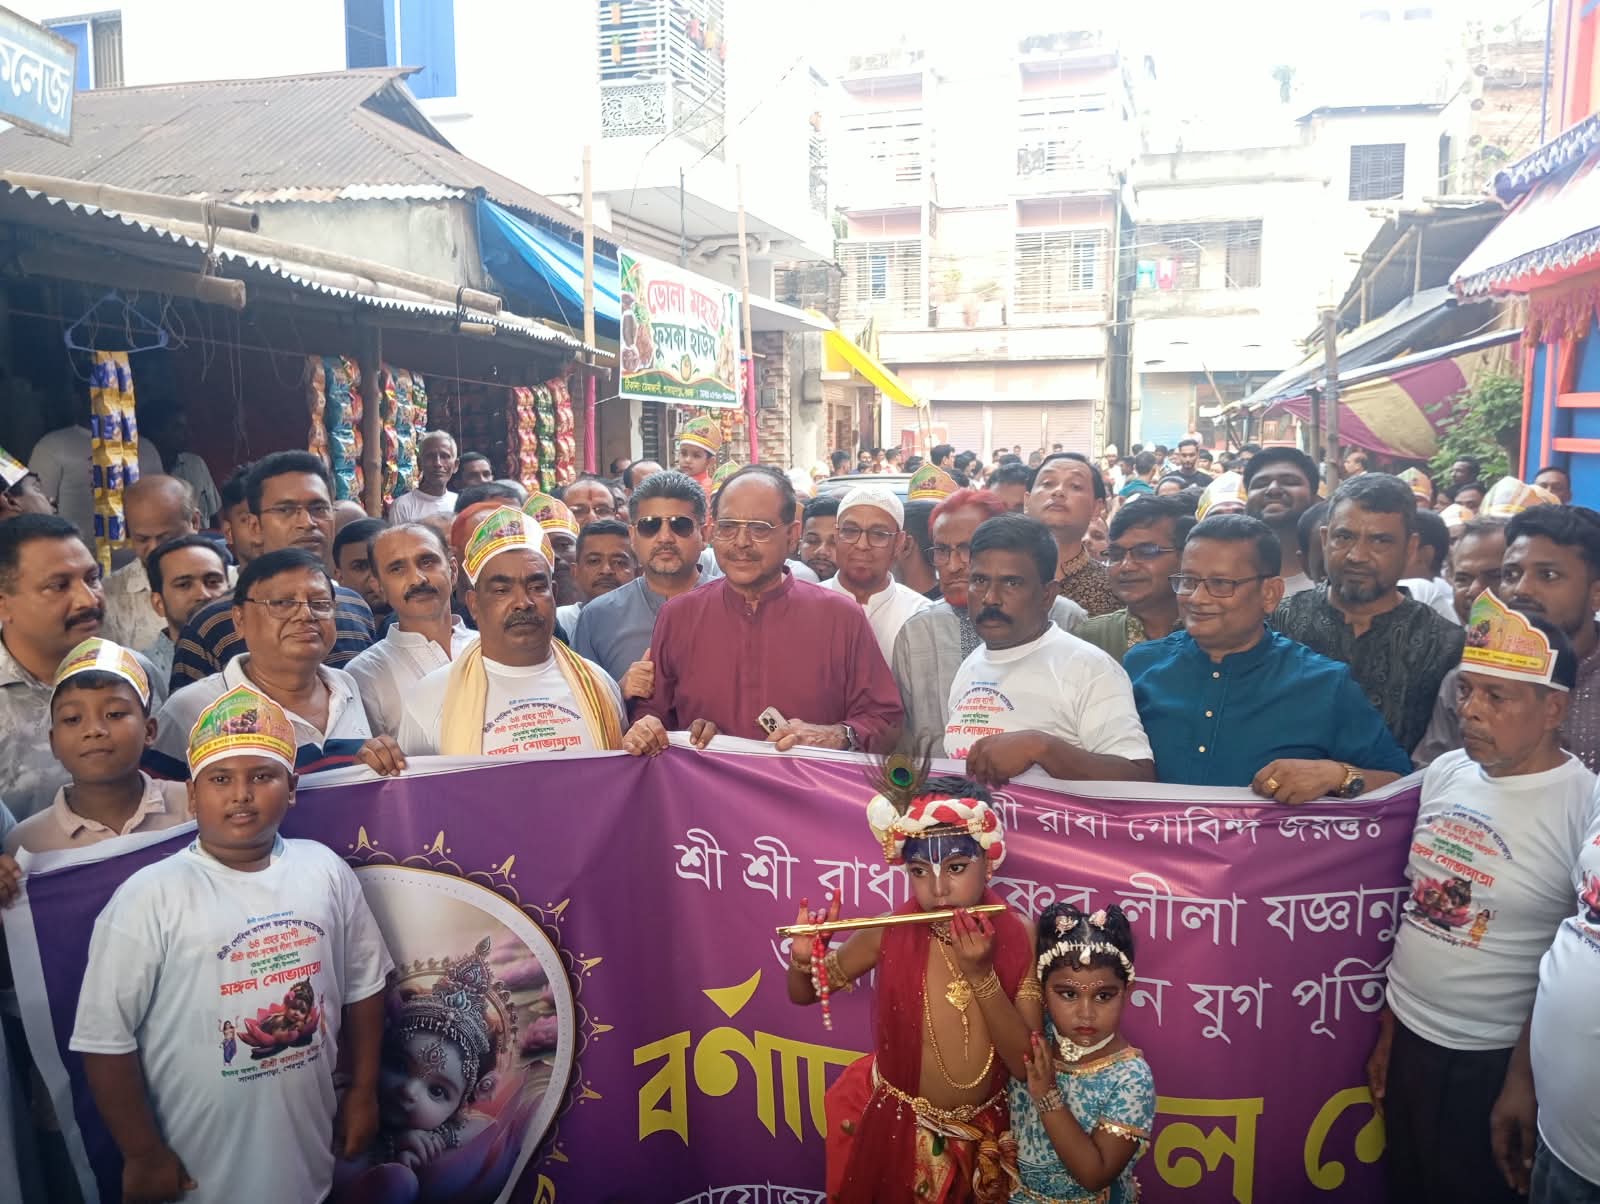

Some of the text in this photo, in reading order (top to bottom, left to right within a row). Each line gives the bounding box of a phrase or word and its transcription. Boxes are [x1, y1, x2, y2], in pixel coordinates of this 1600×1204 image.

[651, 323, 716, 361] ফুসকা হাউস
[523, 735, 582, 752] শোভাযাত্রা
[1034, 805, 1107, 839] রাধা
[1128, 806, 1262, 844] গোবিন্দ
[672, 828, 729, 891] শ্রী
[741, 836, 800, 900] শ্রী
[1114, 872, 1247, 947] লীলা
[1261, 884, 1402, 944] যজ্ঞানু
[220, 960, 321, 996] মঙ্গল শোভাযাত্রা
[1187, 977, 1273, 1044] যুগ
